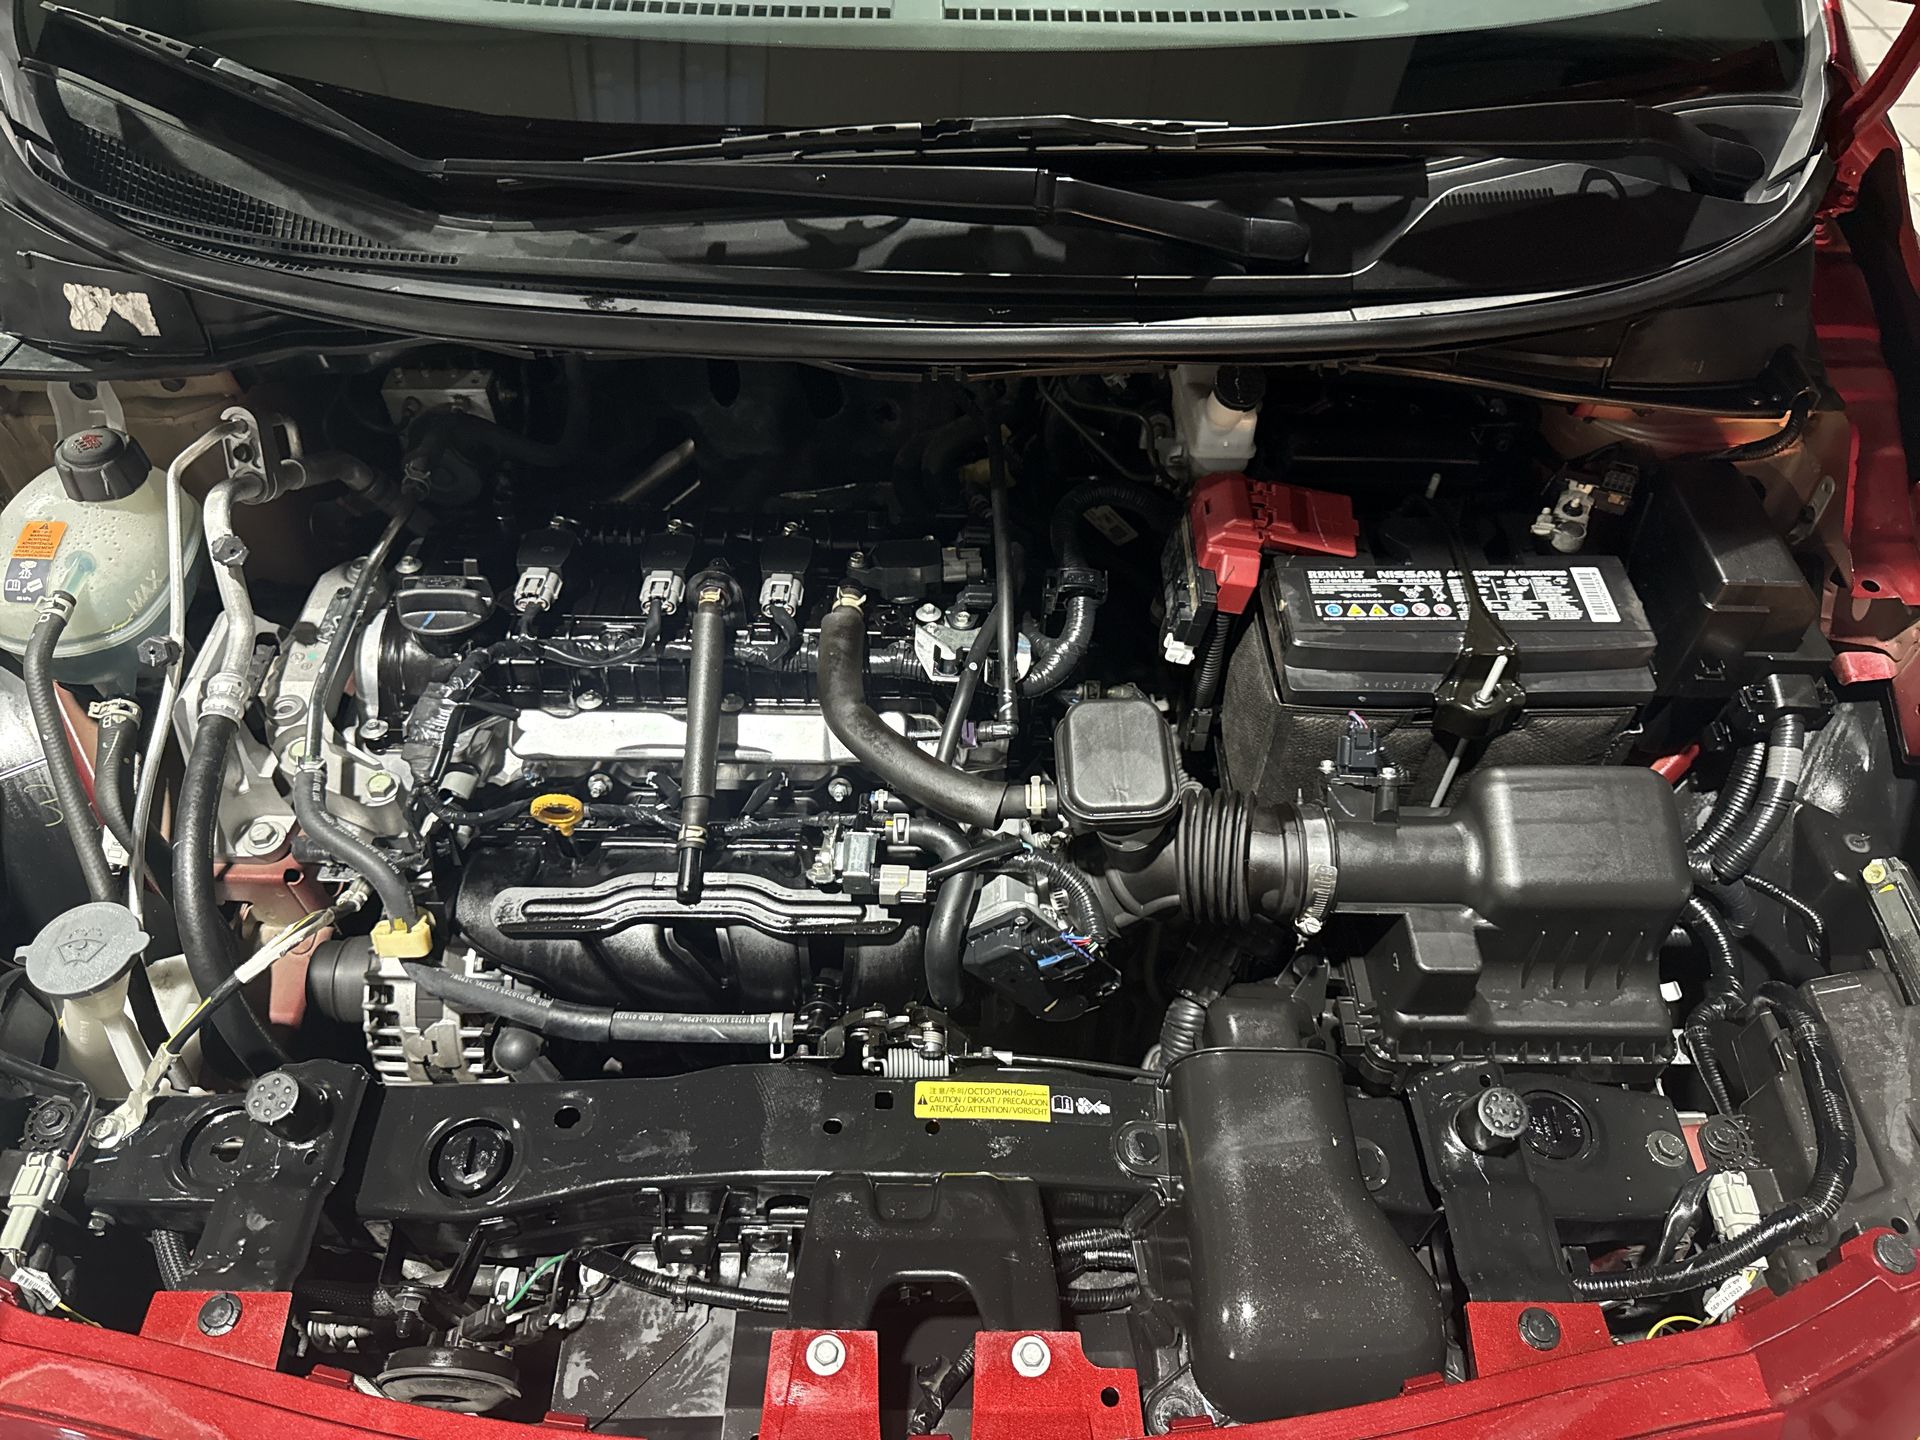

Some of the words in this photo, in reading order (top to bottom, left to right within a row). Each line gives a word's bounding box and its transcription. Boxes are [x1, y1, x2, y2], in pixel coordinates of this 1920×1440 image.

[1306, 570, 1365, 579] RENAULT
[1376, 570, 1442, 579] NISSAN
[126, 569, 163, 612] MAX
[929, 1096, 961, 1104] CAUTION
[967, 1096, 996, 1104] DIKKAT
